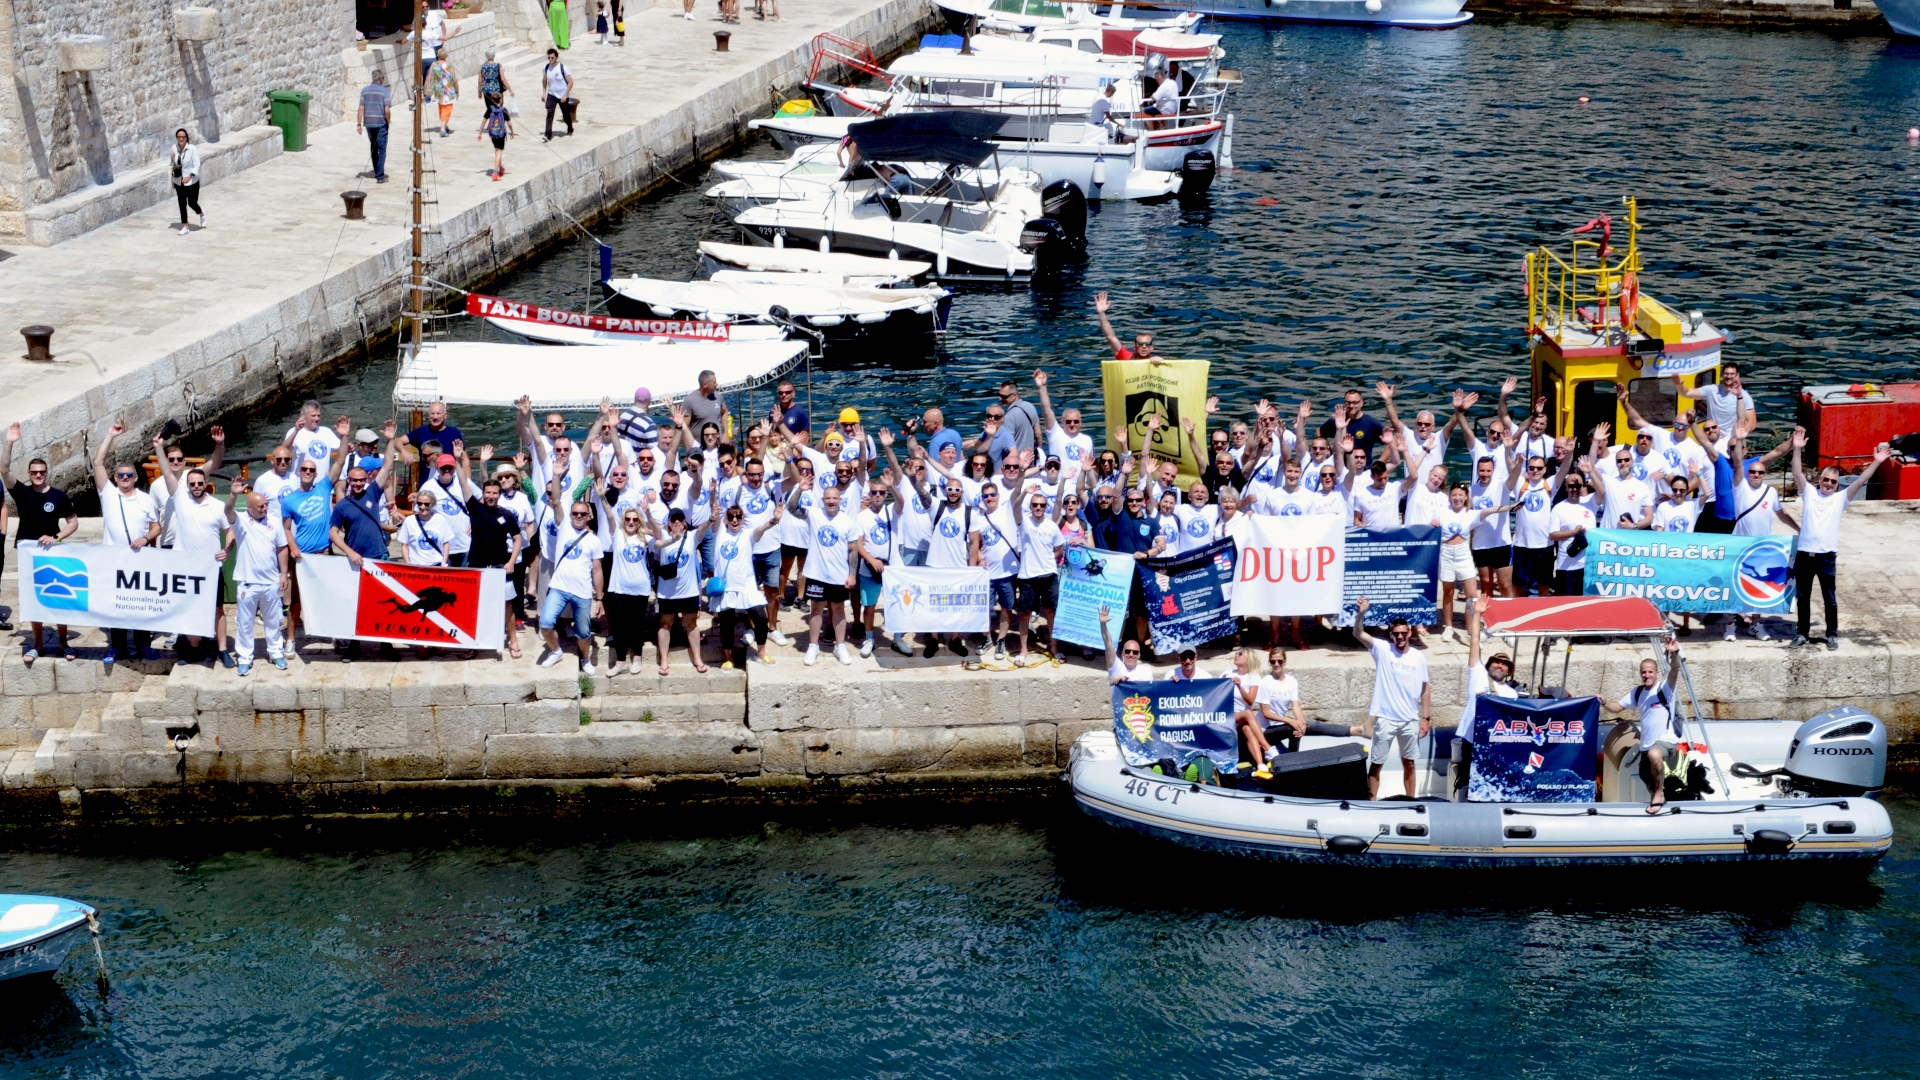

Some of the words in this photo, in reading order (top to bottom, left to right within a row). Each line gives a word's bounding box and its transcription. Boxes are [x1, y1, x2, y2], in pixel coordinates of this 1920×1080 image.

[1044, 190, 1070, 206] MERCURY
[759, 227, 772, 235] 929
[477, 298, 528, 319] TAXI
[1137, 382, 1167, 391] AKTIVNOSTI
[1150, 375, 1179, 386] PODVODNE
[1599, 540, 1726, 560] Ronilački
[1239, 545, 1335, 584] DUUP
[1596, 561, 1656, 578] klub
[116, 569, 206, 596] MLJET
[433, 575, 477, 584] AKTIVNOSTI
[1188, 571, 1209, 580] Dubrovnik
[960, 584, 987, 592] CENTER
[1063, 580, 1125, 602] MARSONIA
[1595, 581, 1730, 601] VINKOVCI
[116, 594, 154, 603] Nacionalni
[155, 598, 171, 606] park
[931, 594, 987, 605] AMFORA
[1062, 591, 1100, 605] SLAVONSKI
[1103, 600, 1123, 610] BROD
[115, 603, 147, 611] National
[375, 622, 458, 638] VUKOVAR
[1158, 694, 1202, 709] EKOLOŠKO
[1159, 712, 1204, 726] RONILAČKI
[1205, 712, 1227, 724] KLUB
[1490, 716, 1586, 736] ABYSS
[1160, 730, 1195, 742] RAGUSA
[1548, 735, 1584, 743] CROATIA
[1813, 747, 1875, 756] HONDA
[1125, 778, 1150, 797] 46
[1154, 784, 1187, 805] CT
